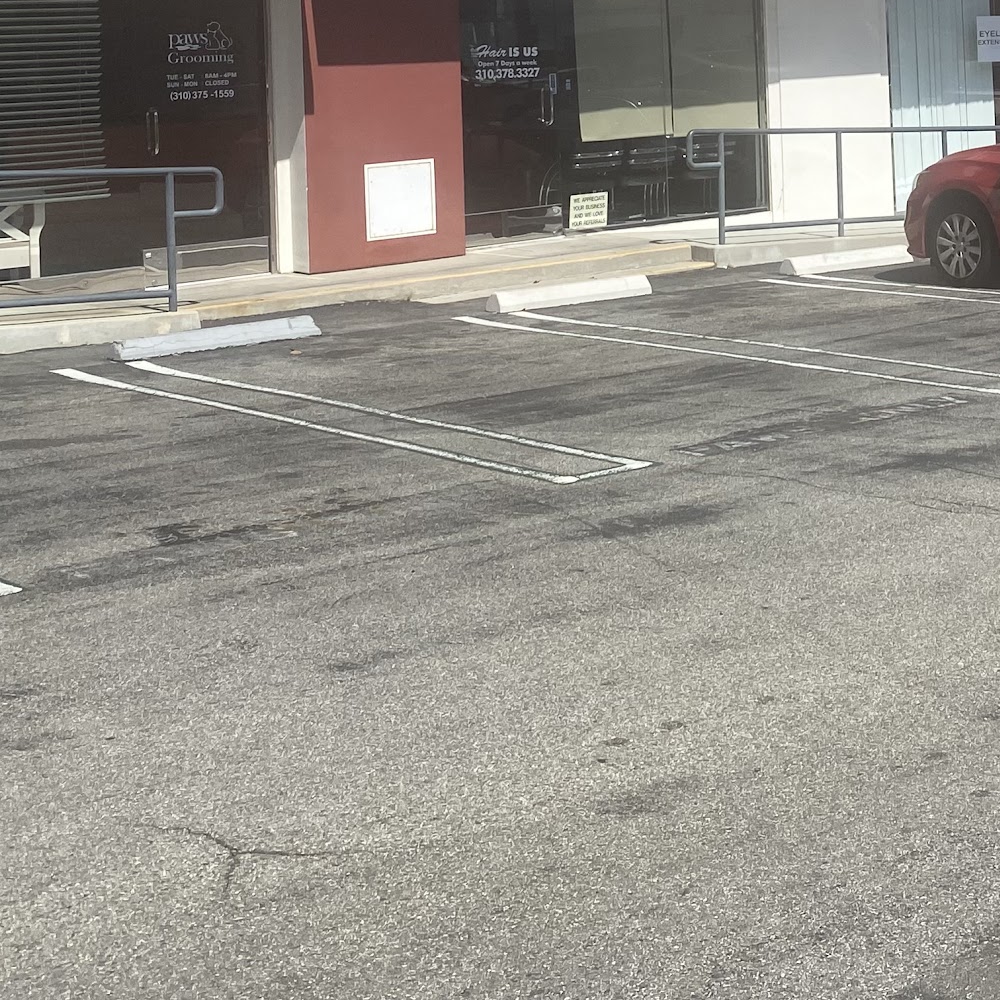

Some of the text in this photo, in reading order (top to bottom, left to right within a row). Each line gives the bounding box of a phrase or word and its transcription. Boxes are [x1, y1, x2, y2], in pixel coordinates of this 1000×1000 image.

[167, 51, 234, 64] Grooming
[477, 44, 539, 58] Hair IS US
[477, 60, 494, 68] Open
